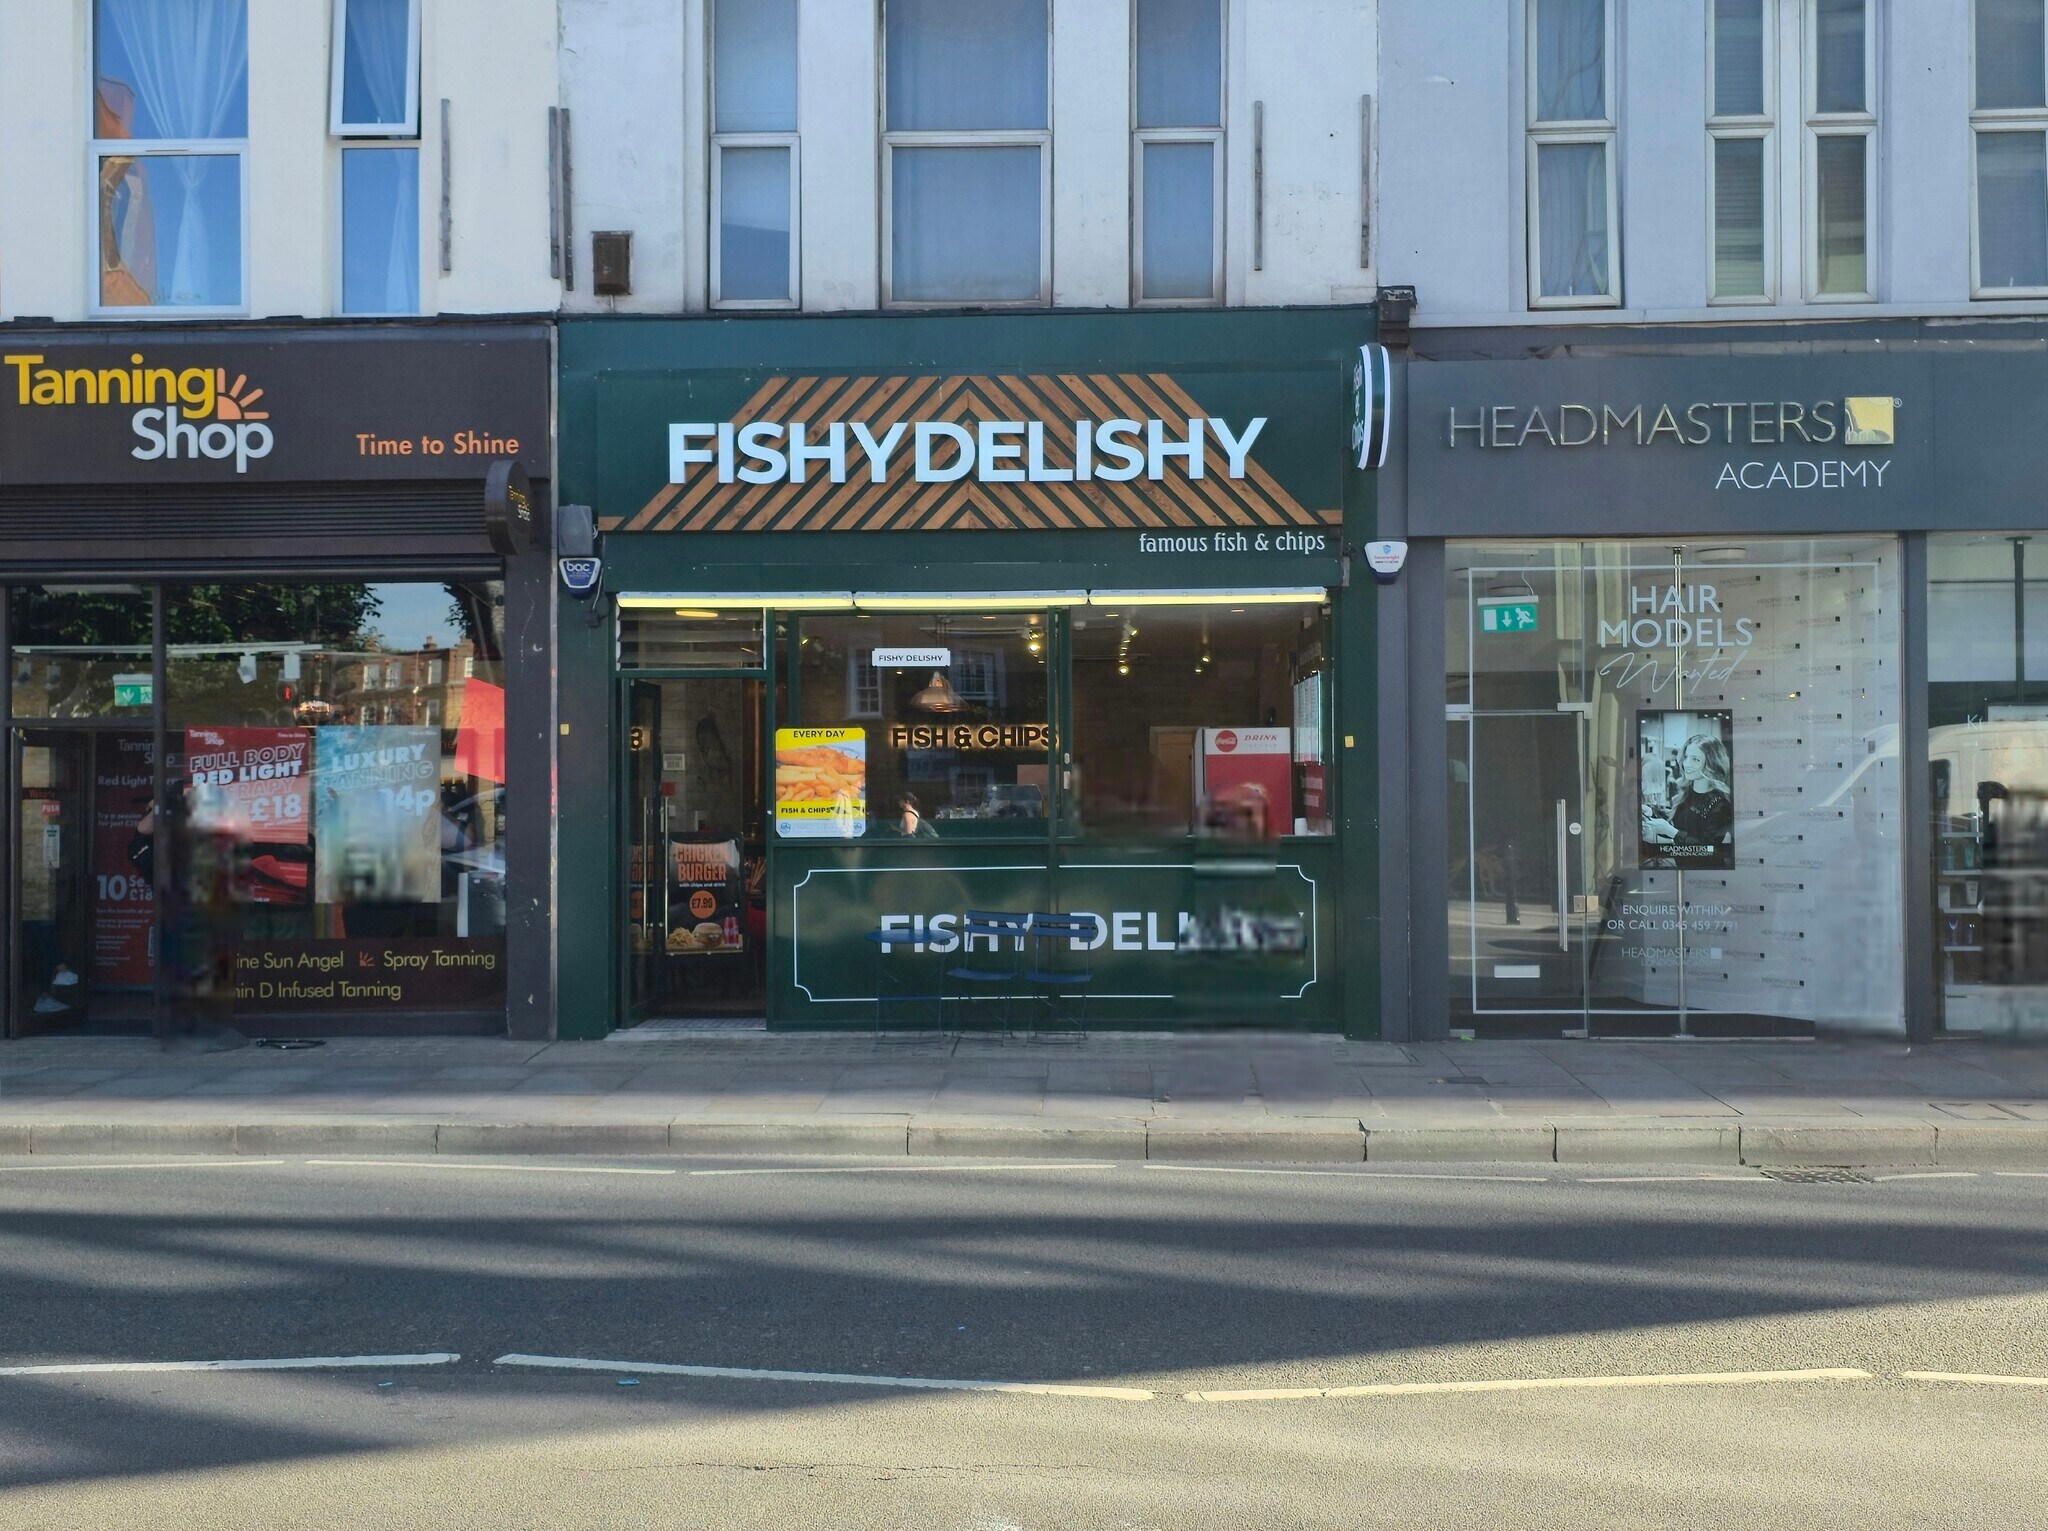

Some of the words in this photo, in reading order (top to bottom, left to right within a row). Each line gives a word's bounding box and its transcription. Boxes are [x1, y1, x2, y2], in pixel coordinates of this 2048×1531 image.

[4, 353, 215, 419] Tanning
[1449, 401, 1837, 448] HEADMASTERS
[131, 405, 274, 474] Shop
[356, 433, 413, 456] Time
[421, 435, 445, 455] to
[453, 430, 520, 455] Shine
[1715, 460, 1892, 490] ACADEMY
[1139, 533, 1208, 553] famous
[1213, 531, 1248, 552] fish
[1254, 532, 1269, 551] &
[1275, 531, 1326, 554] chips
[566, 560, 590, 572] bac
[1631, 584, 1721, 614] HAIR
[1600, 617, 1753, 648] MODELS
[878, 654, 904, 662] FISHY
[906, 654, 943, 662] DELISHY
[1600, 648, 1748, 694] Wanted
[189, 729, 218, 740] Tanning
[793, 730, 823, 738] EVERY
[825, 730, 846, 738] DAY
[892, 727, 948, 748] FISH
[954, 727, 972, 748] &
[978, 727, 1057, 748] CHIPS
[190, 751, 239, 773] FULL
[243, 742, 306, 767] BODY
[331, 743, 426, 773] LUXURY
[98, 776, 119, 786] Red
[122, 775, 147, 788] Light
[192, 769, 234, 787] RED
[239, 760, 302, 782] LIGHT
[42, 804, 60, 812] PUSH
[250, 794, 302, 822] £18
[676, 844, 729, 862] CHICKEN
[678, 862, 727, 881] BURGER
[97, 874, 127, 901] 10
[1622, 904, 1675, 916] ENQUIRE
[1677, 904, 1724, 915] WITHIN
[1607, 919, 1625, 930] OR
[1628, 919, 1659, 930] CALL
[1662, 919, 1688, 930] 0345
[1691, 919, 1710, 930] 459
[263, 952, 294, 969] Sun
[297, 951, 344, 972] Angel
[383, 951, 429, 971] Spray
[432, 950, 496, 970] Tanning
[1621, 948, 1710, 959] HEADMASTERS
[259, 982, 273, 998] D
[278, 981, 334, 998] Infused
[338, 981, 402, 1001] Tanning
